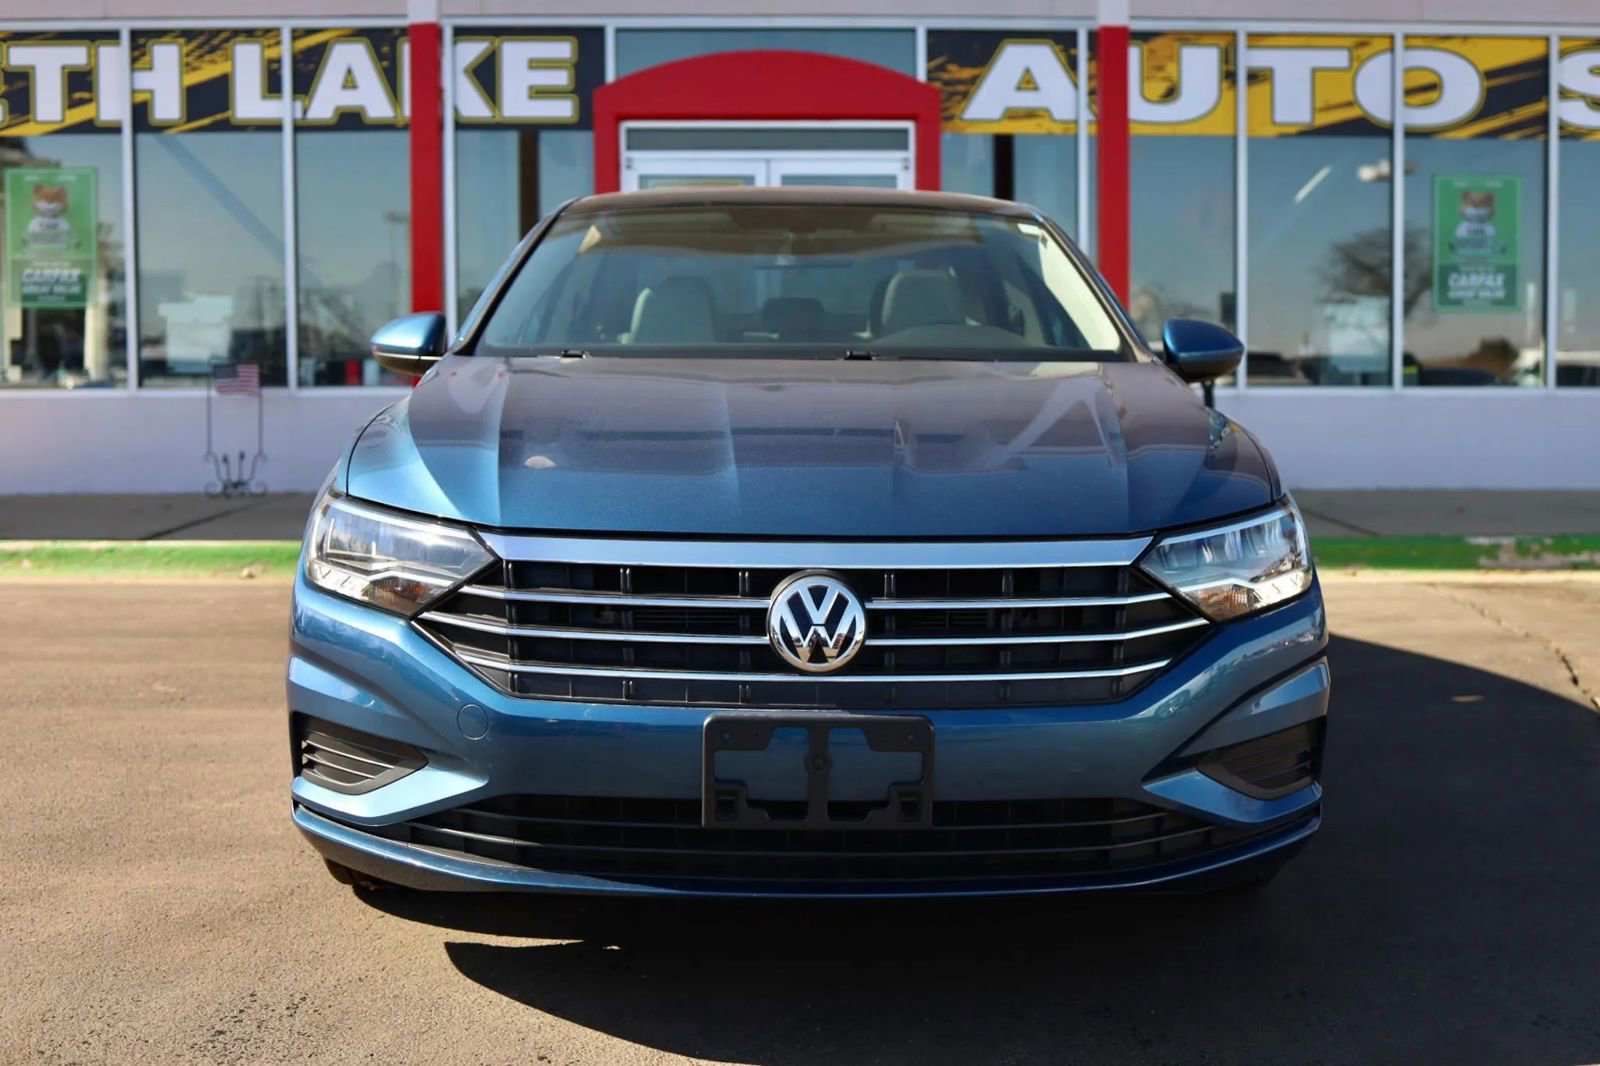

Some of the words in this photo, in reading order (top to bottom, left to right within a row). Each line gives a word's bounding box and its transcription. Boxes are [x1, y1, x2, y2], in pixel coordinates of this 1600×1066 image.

[0, 41, 187, 126] TH
[229, 37, 579, 125] LAKE
[956, 38, 1487, 132] AUTO
